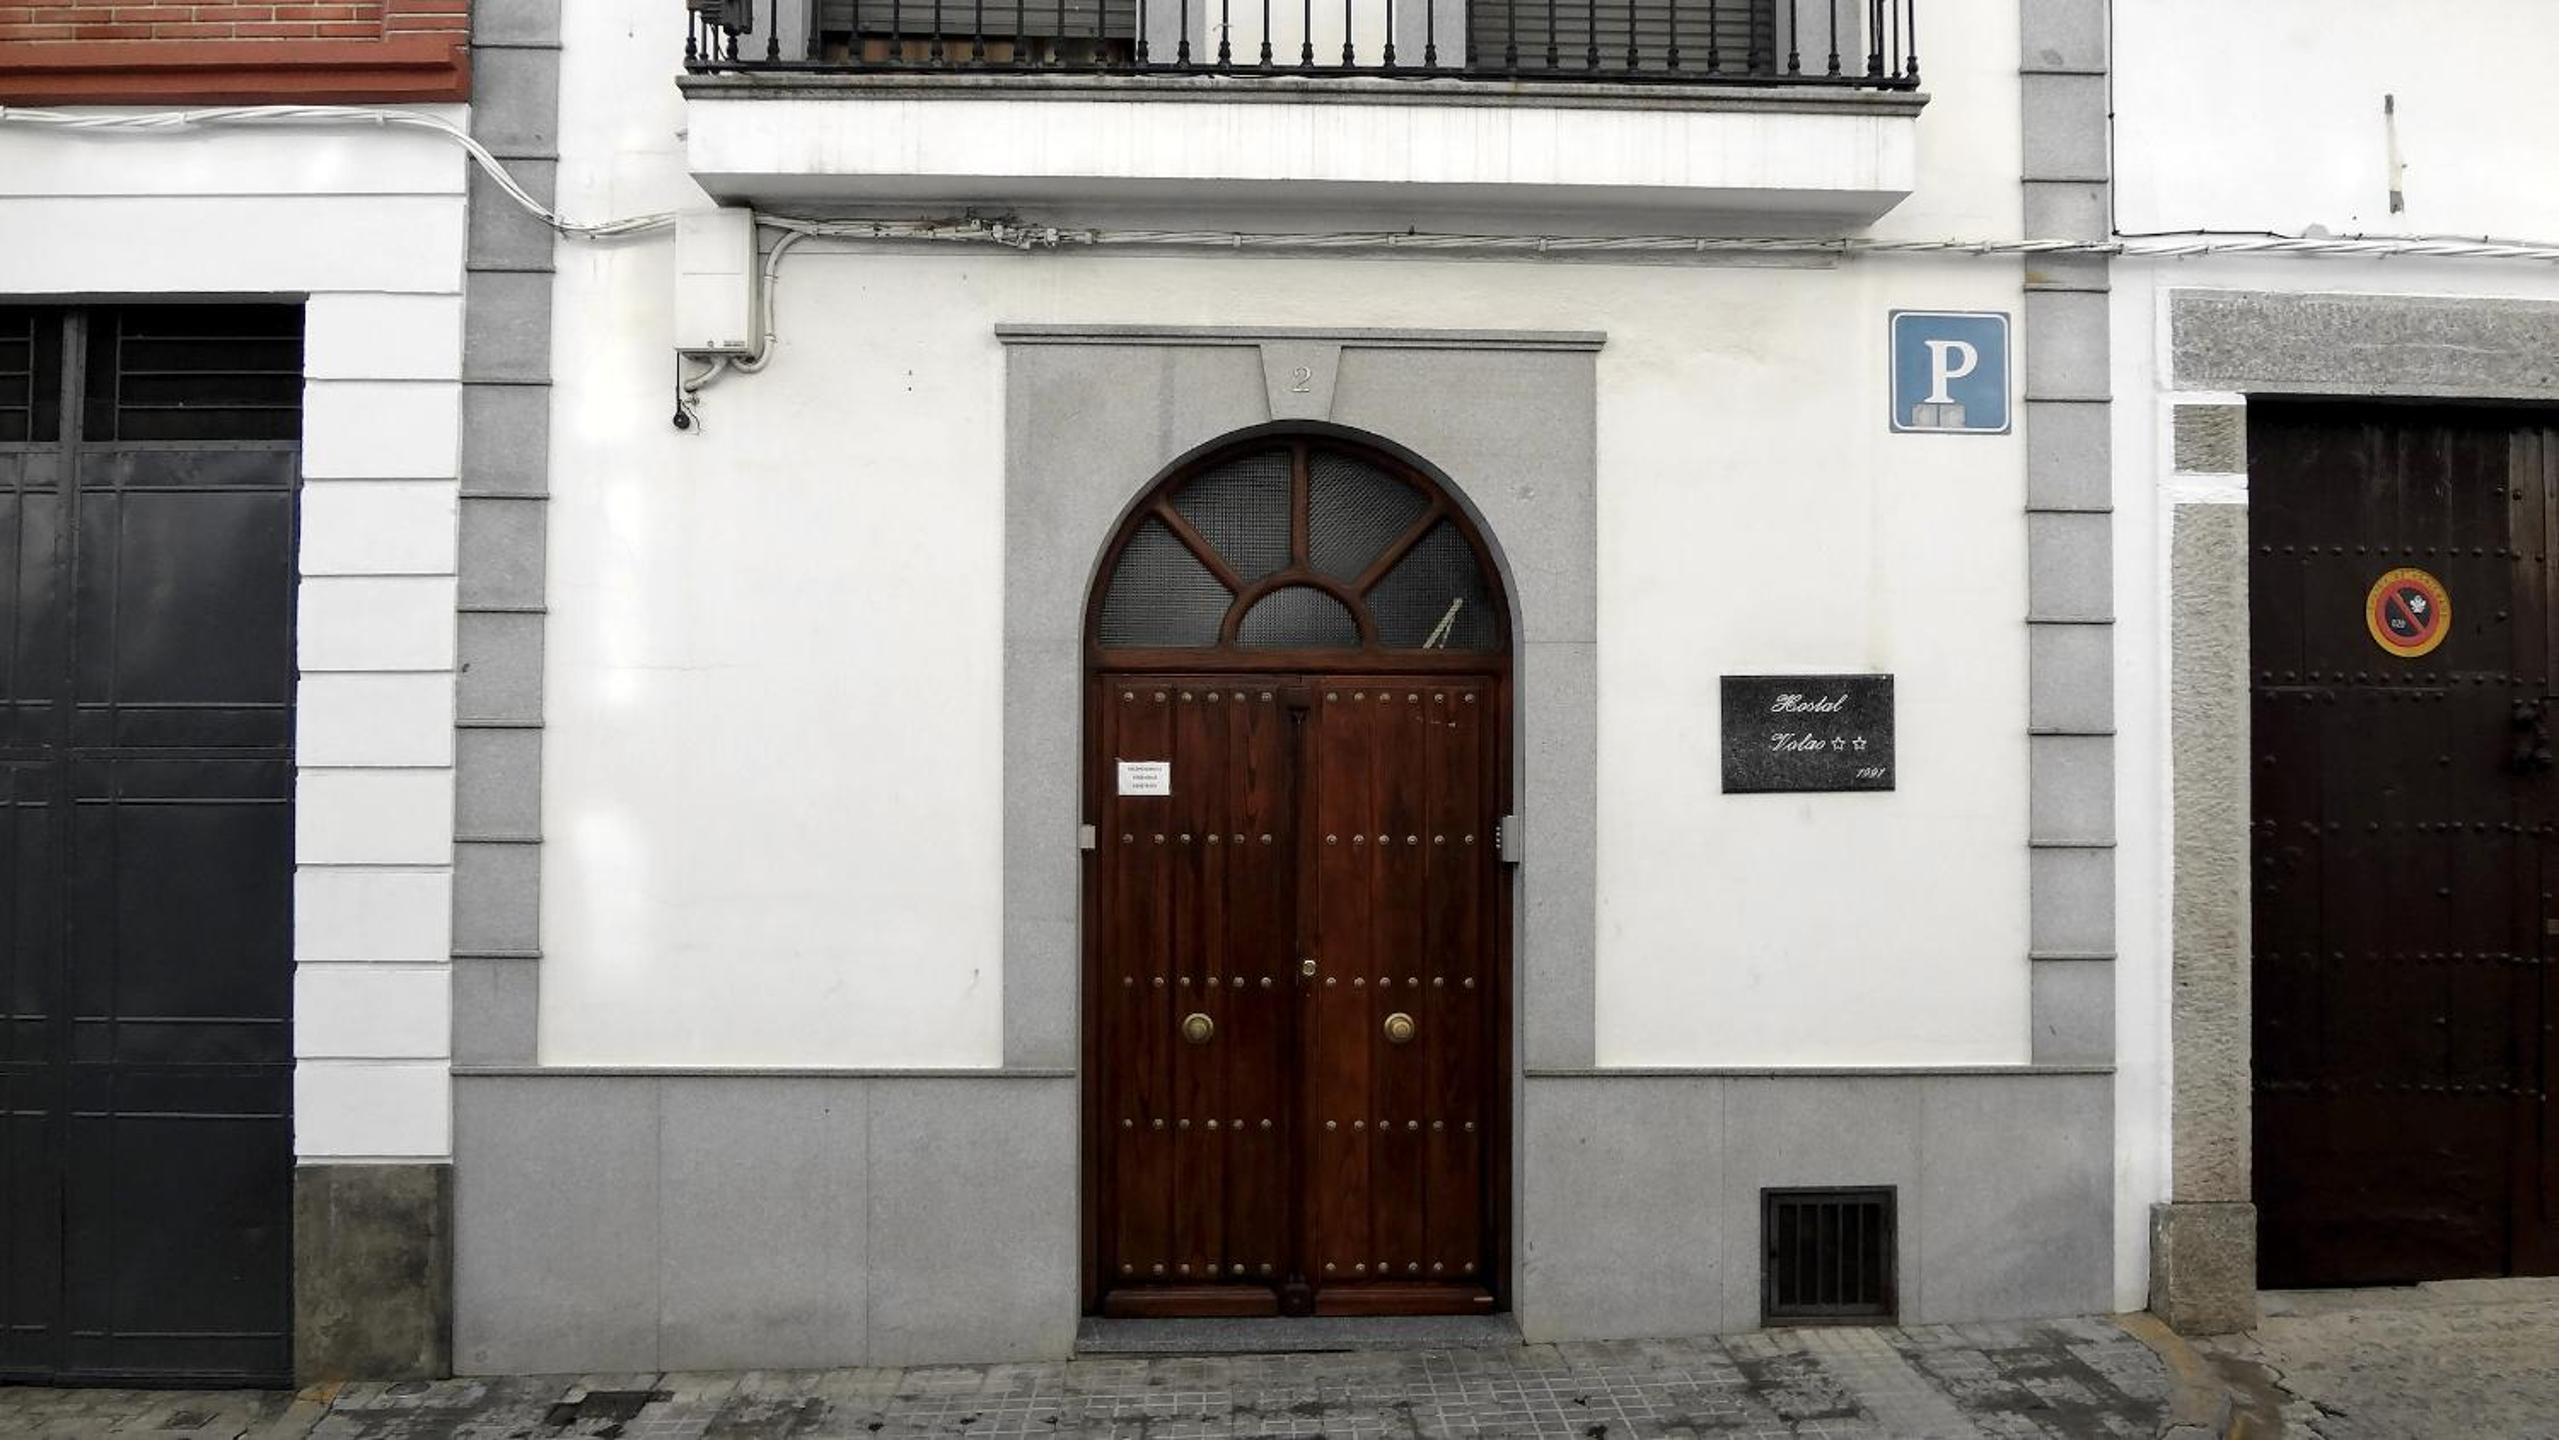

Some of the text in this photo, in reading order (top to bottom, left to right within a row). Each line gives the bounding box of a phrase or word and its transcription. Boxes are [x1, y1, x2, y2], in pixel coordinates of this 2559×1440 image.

[1292, 366, 1312, 393] 2
[1923, 340, 1978, 403] P
[1771, 694, 1848, 713] Hostal
[1856, 767, 1886, 779] 1991
